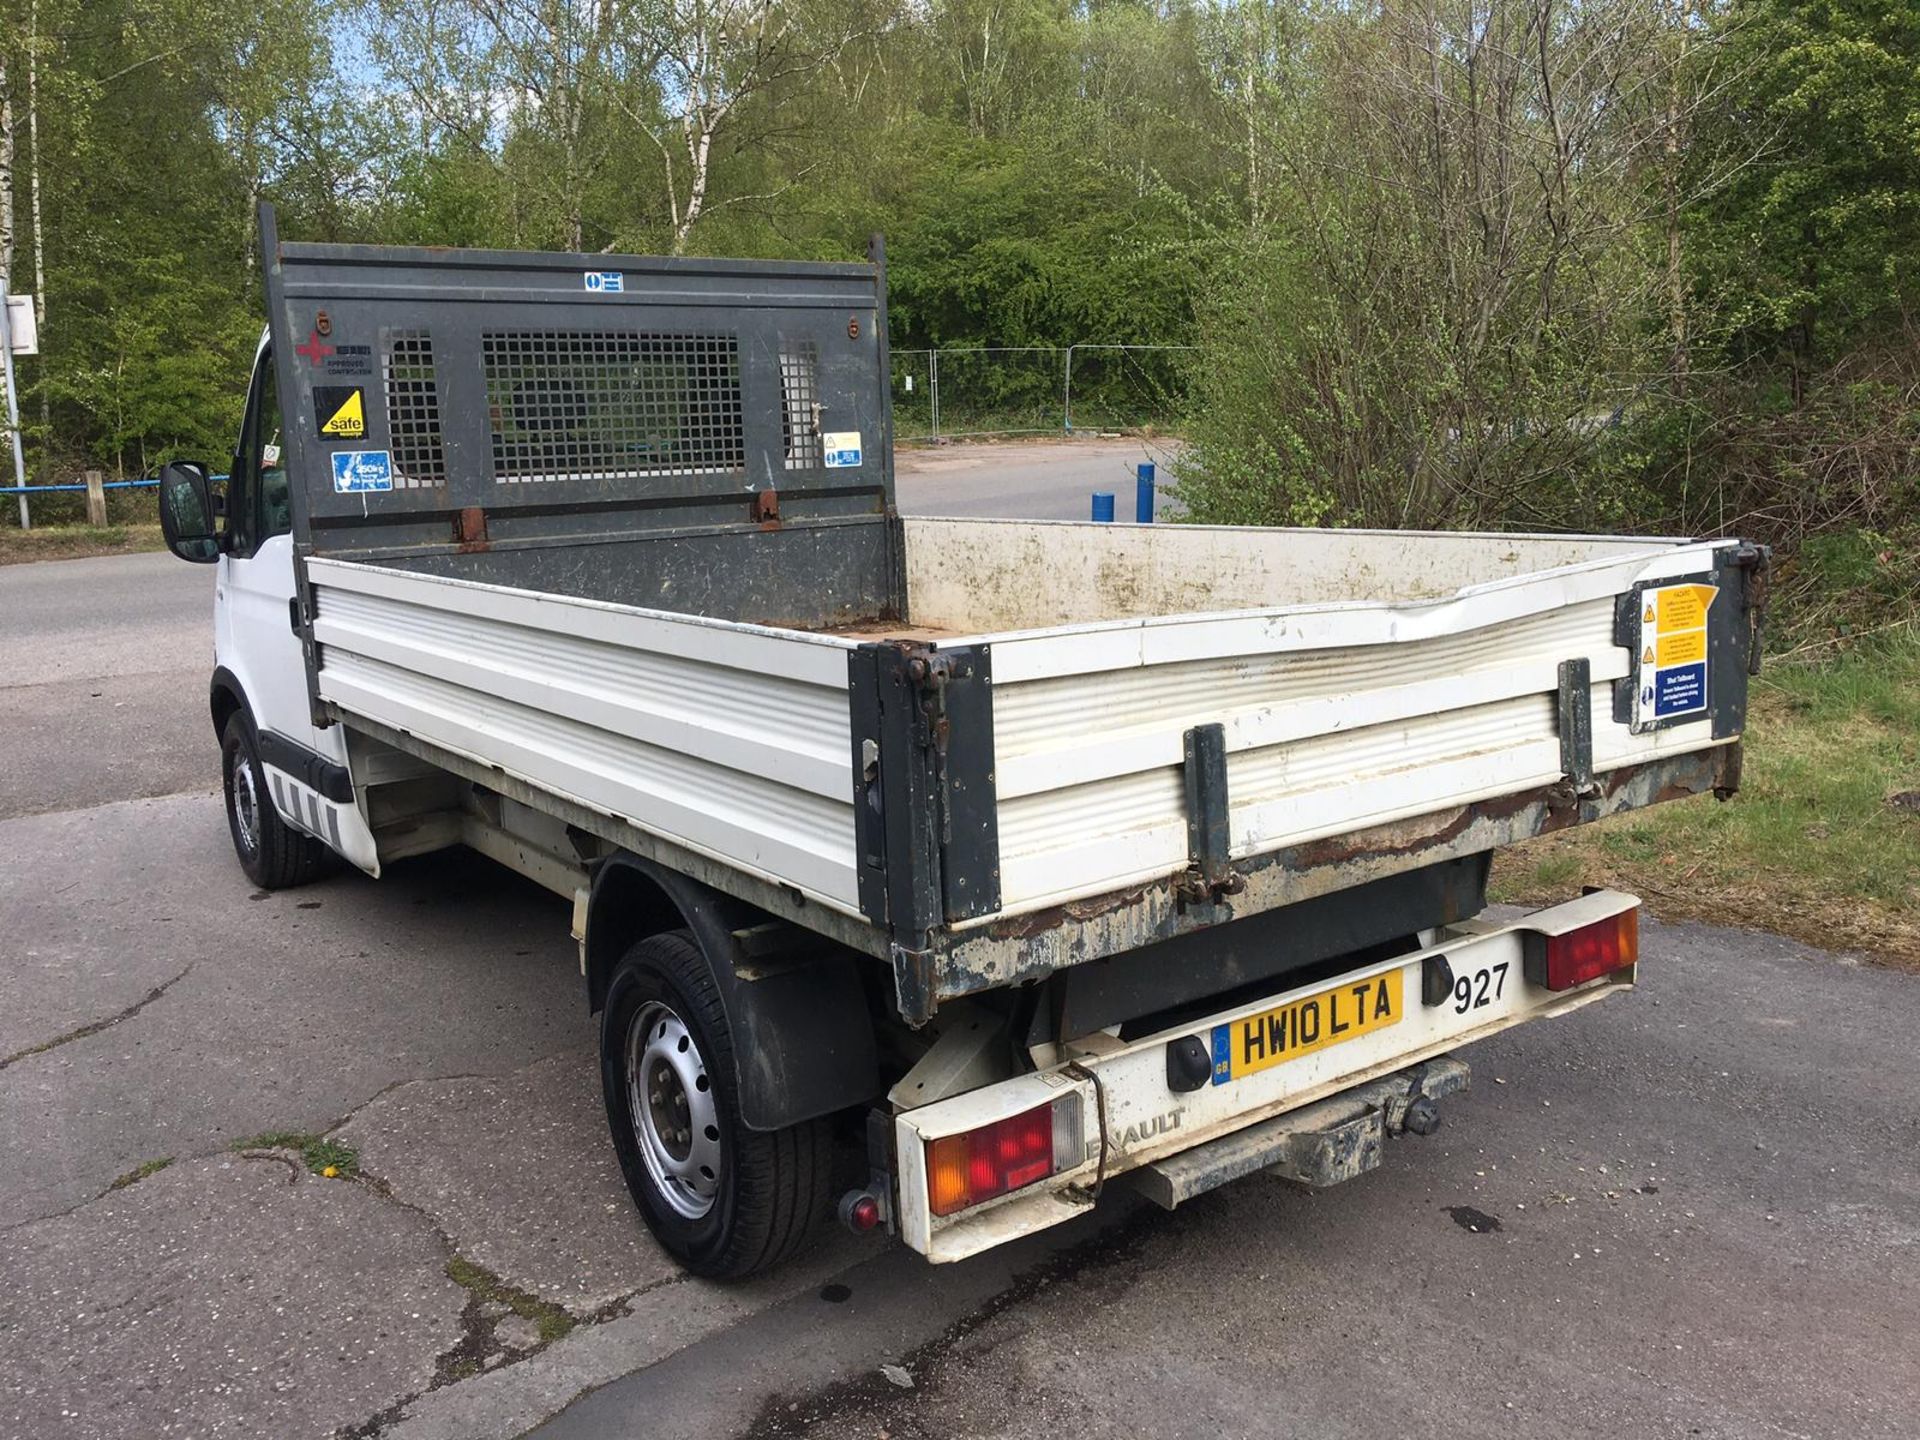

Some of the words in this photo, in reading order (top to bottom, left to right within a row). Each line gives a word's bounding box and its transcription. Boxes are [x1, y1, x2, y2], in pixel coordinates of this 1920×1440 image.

[330, 416, 361, 430] safe
[1455, 961, 1509, 1015] 927
[1215, 1060, 1229, 1075] GB
